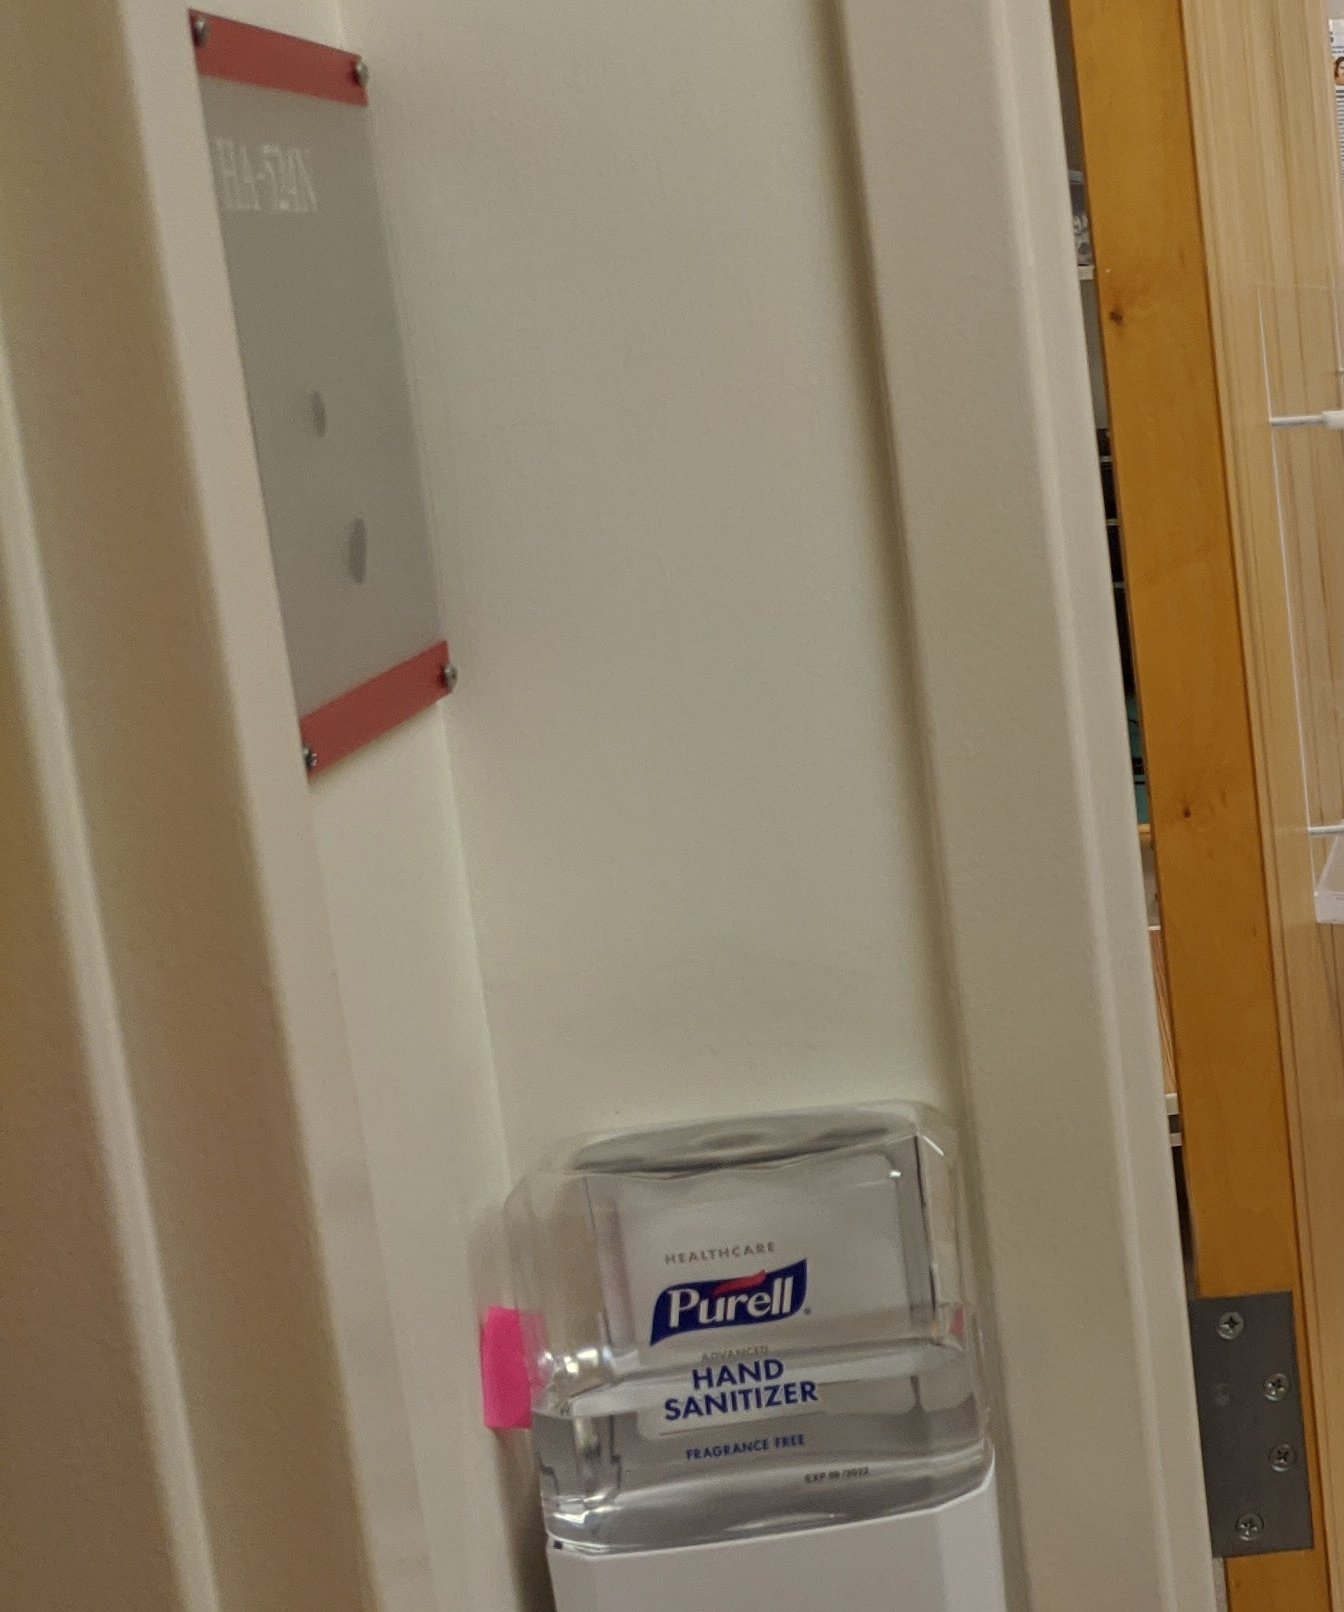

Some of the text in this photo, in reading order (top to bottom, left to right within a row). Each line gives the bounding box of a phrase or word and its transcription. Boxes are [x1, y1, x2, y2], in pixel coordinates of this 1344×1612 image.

[665, 1242, 775, 1264] HEALTHCARE
[667, 1274, 795, 1328] Purell
[691, 1358, 785, 1390] HAND
[663, 1381, 819, 1421] SANITIZER
[685, 1433, 806, 1460] FRAGRANCE FREE
